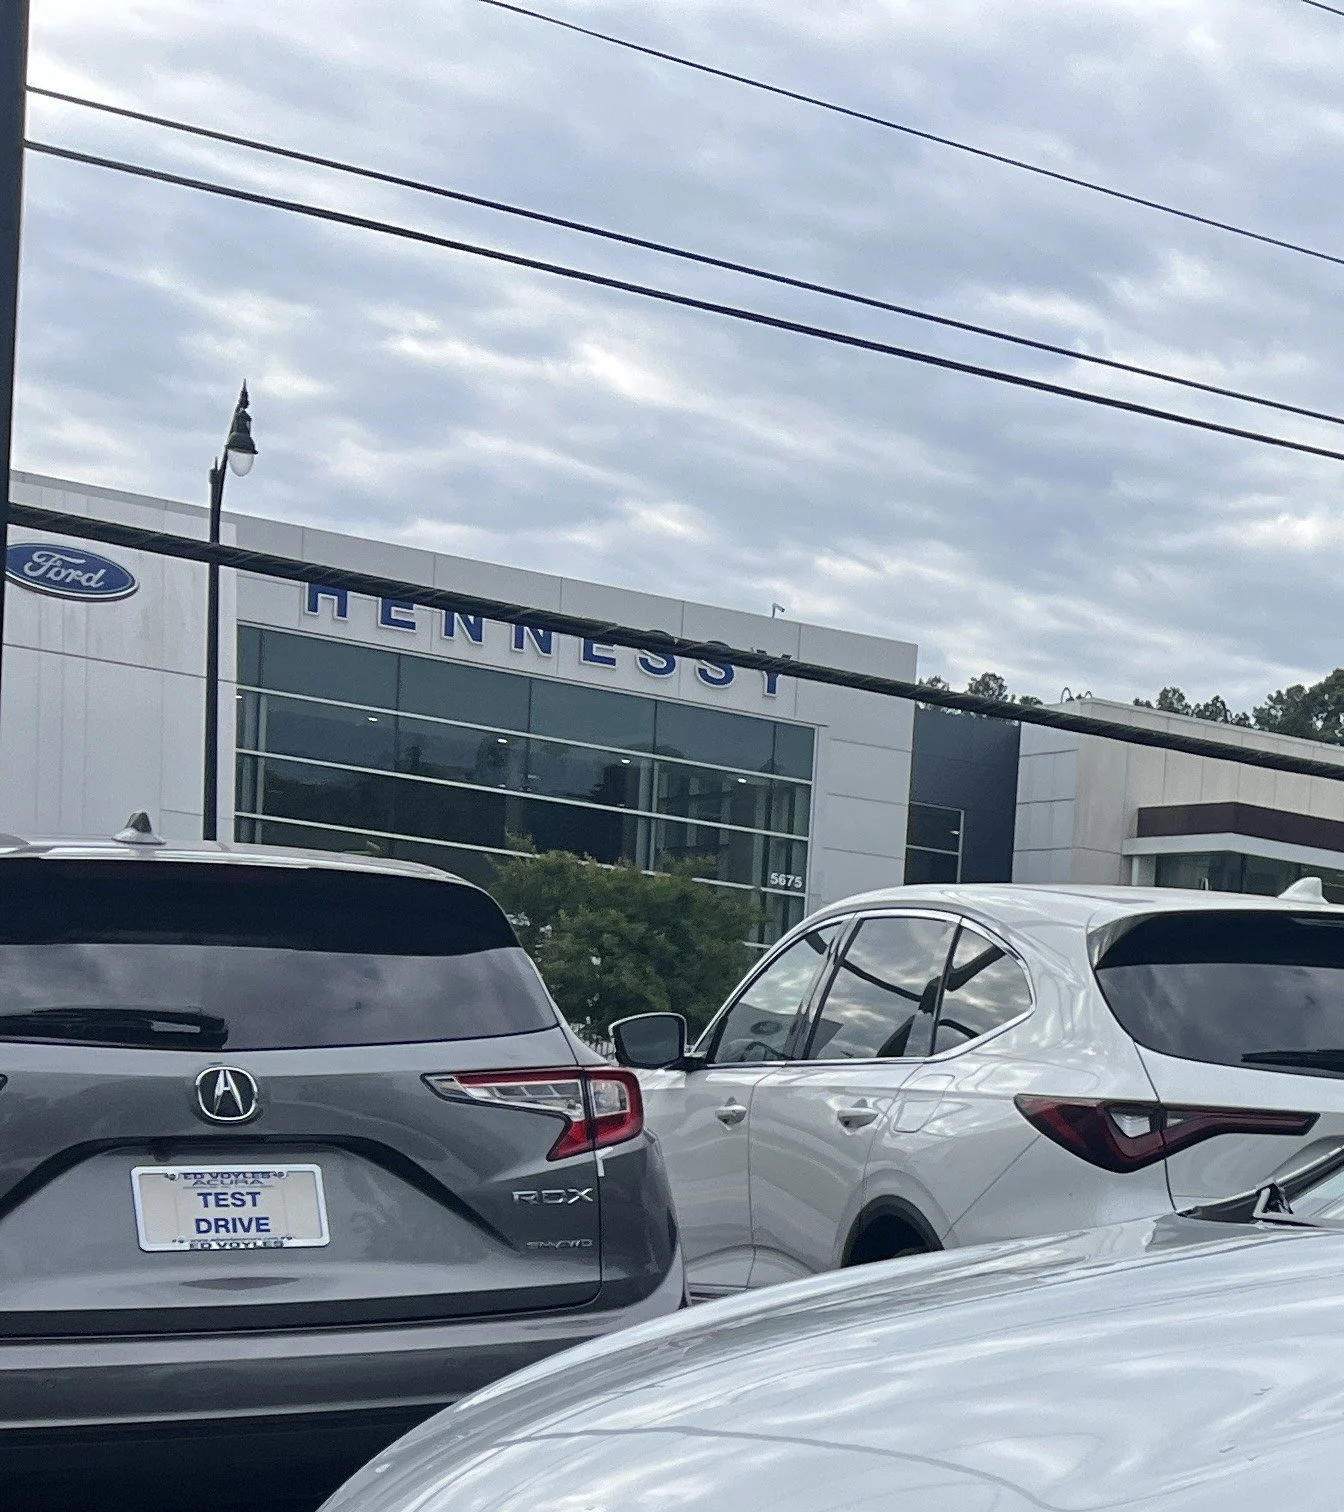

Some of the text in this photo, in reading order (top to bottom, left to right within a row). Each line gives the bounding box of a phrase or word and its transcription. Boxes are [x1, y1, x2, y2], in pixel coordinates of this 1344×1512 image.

[23, 550, 106, 588] Ford
[770, 872, 803, 889] 5675
[192, 1179, 264, 1187] ACURA
[197, 1191, 261, 1209] TEST
[512, 1187, 594, 1206] RDX
[195, 1216, 271, 1234] DRIVE
